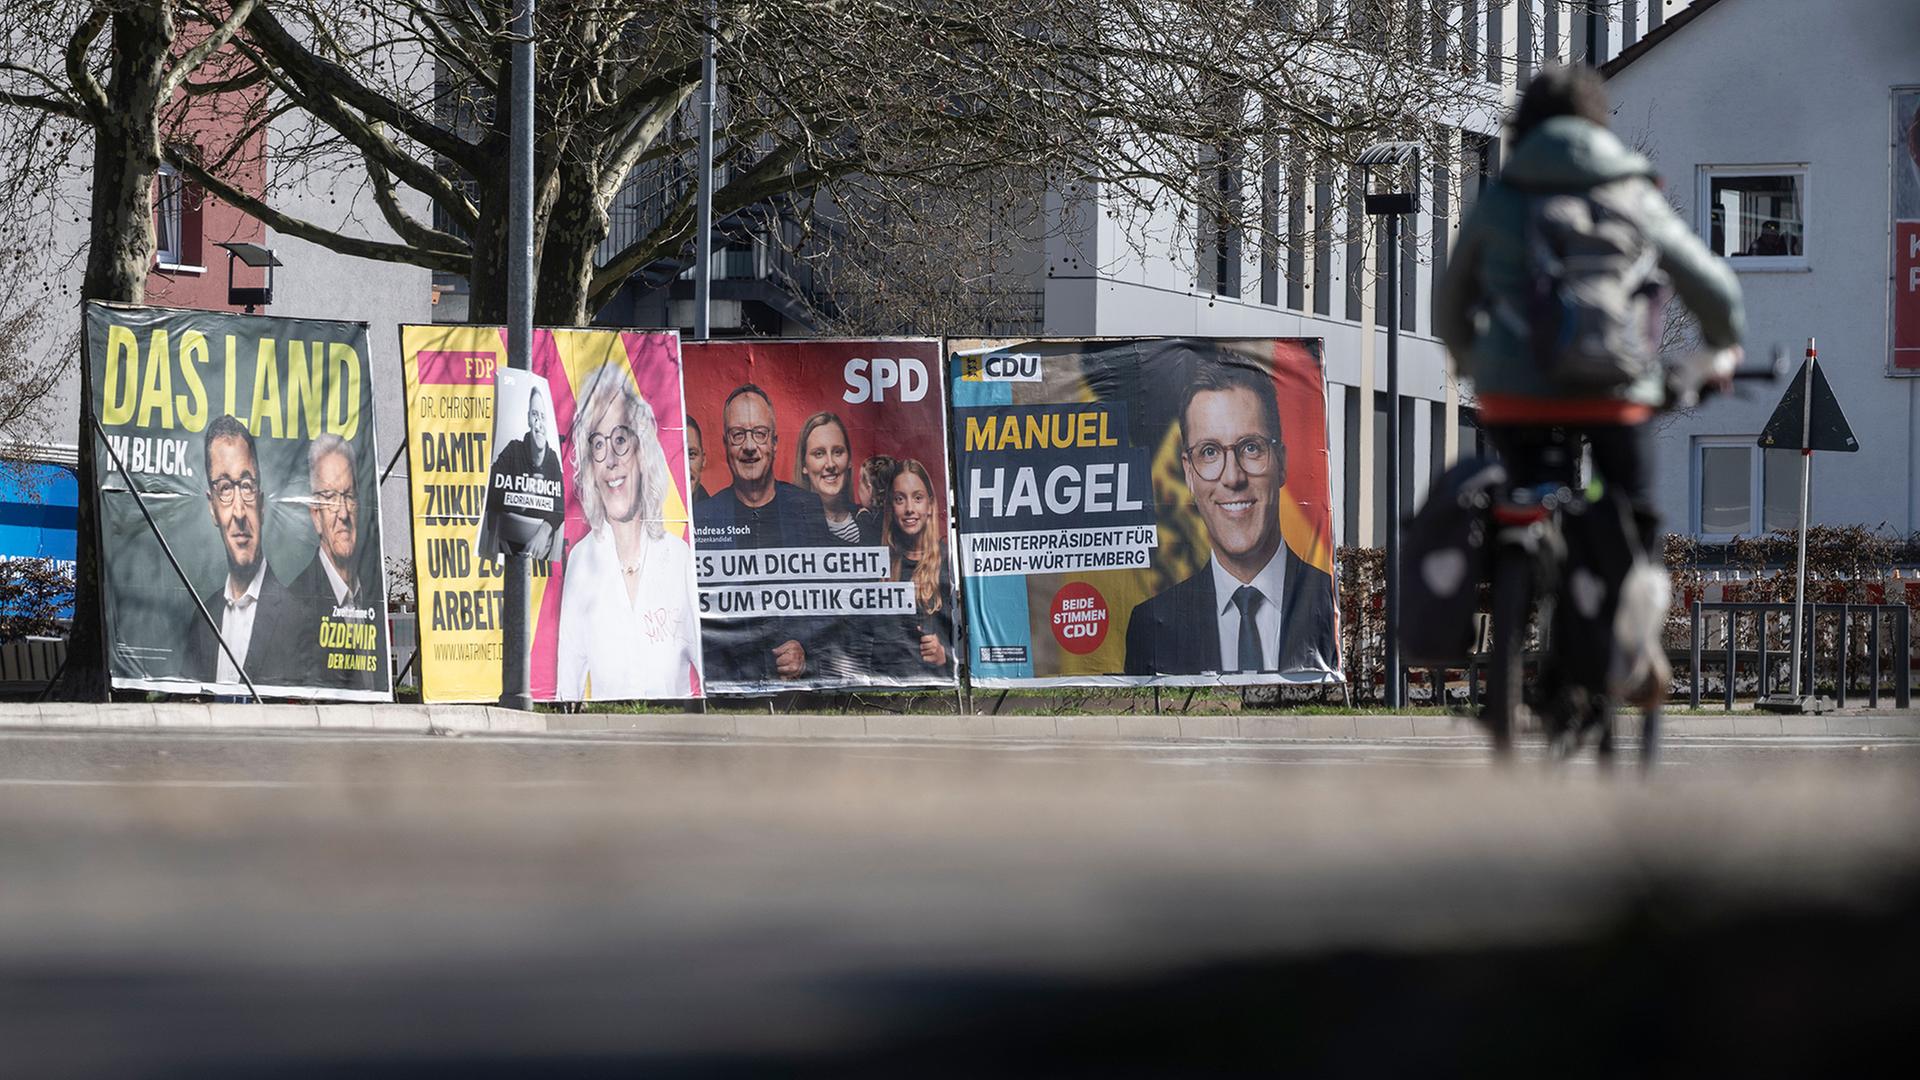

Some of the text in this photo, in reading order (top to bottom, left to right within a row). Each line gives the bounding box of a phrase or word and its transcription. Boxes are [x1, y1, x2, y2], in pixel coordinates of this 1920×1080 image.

[464, 357, 494, 379] FDP
[985, 357, 1038, 378] CDU
[103, 325, 361, 441] DAS LAND
[843, 358, 929, 404] SPD
[420, 396, 491, 419] DR. CHRISTINE
[965, 412, 1118, 452] MANUEL
[107, 435, 193, 477] IM BLICK.
[422, 432, 487, 473] DAMIT
[495, 473, 561, 497] DA FÜR DICH!
[969, 462, 1143, 519] HAGEL
[506, 494, 534, 506] FLORIAN
[726, 524, 750, 535] Stoch
[972, 526, 1154, 553] MINISTERPRÄSIDENT FÜR
[427, 538, 471, 578] UND
[721, 554, 759, 576] UM
[764, 553, 816, 575] DICH
[823, 552, 887, 577] GEHT,
[974, 550, 1146, 573] BADEN-WÜRTTEMBERG
[699, 587, 913, 613] S UM POLITIK GEHT.
[1062, 597, 1095, 611] BEIDE
[1053, 608, 1106, 624] STIMMEN
[320, 616, 377, 650] ÖZDEMIR
[1063, 622, 1098, 639] CDU
[327, 653, 377, 671] DER KANN ES
